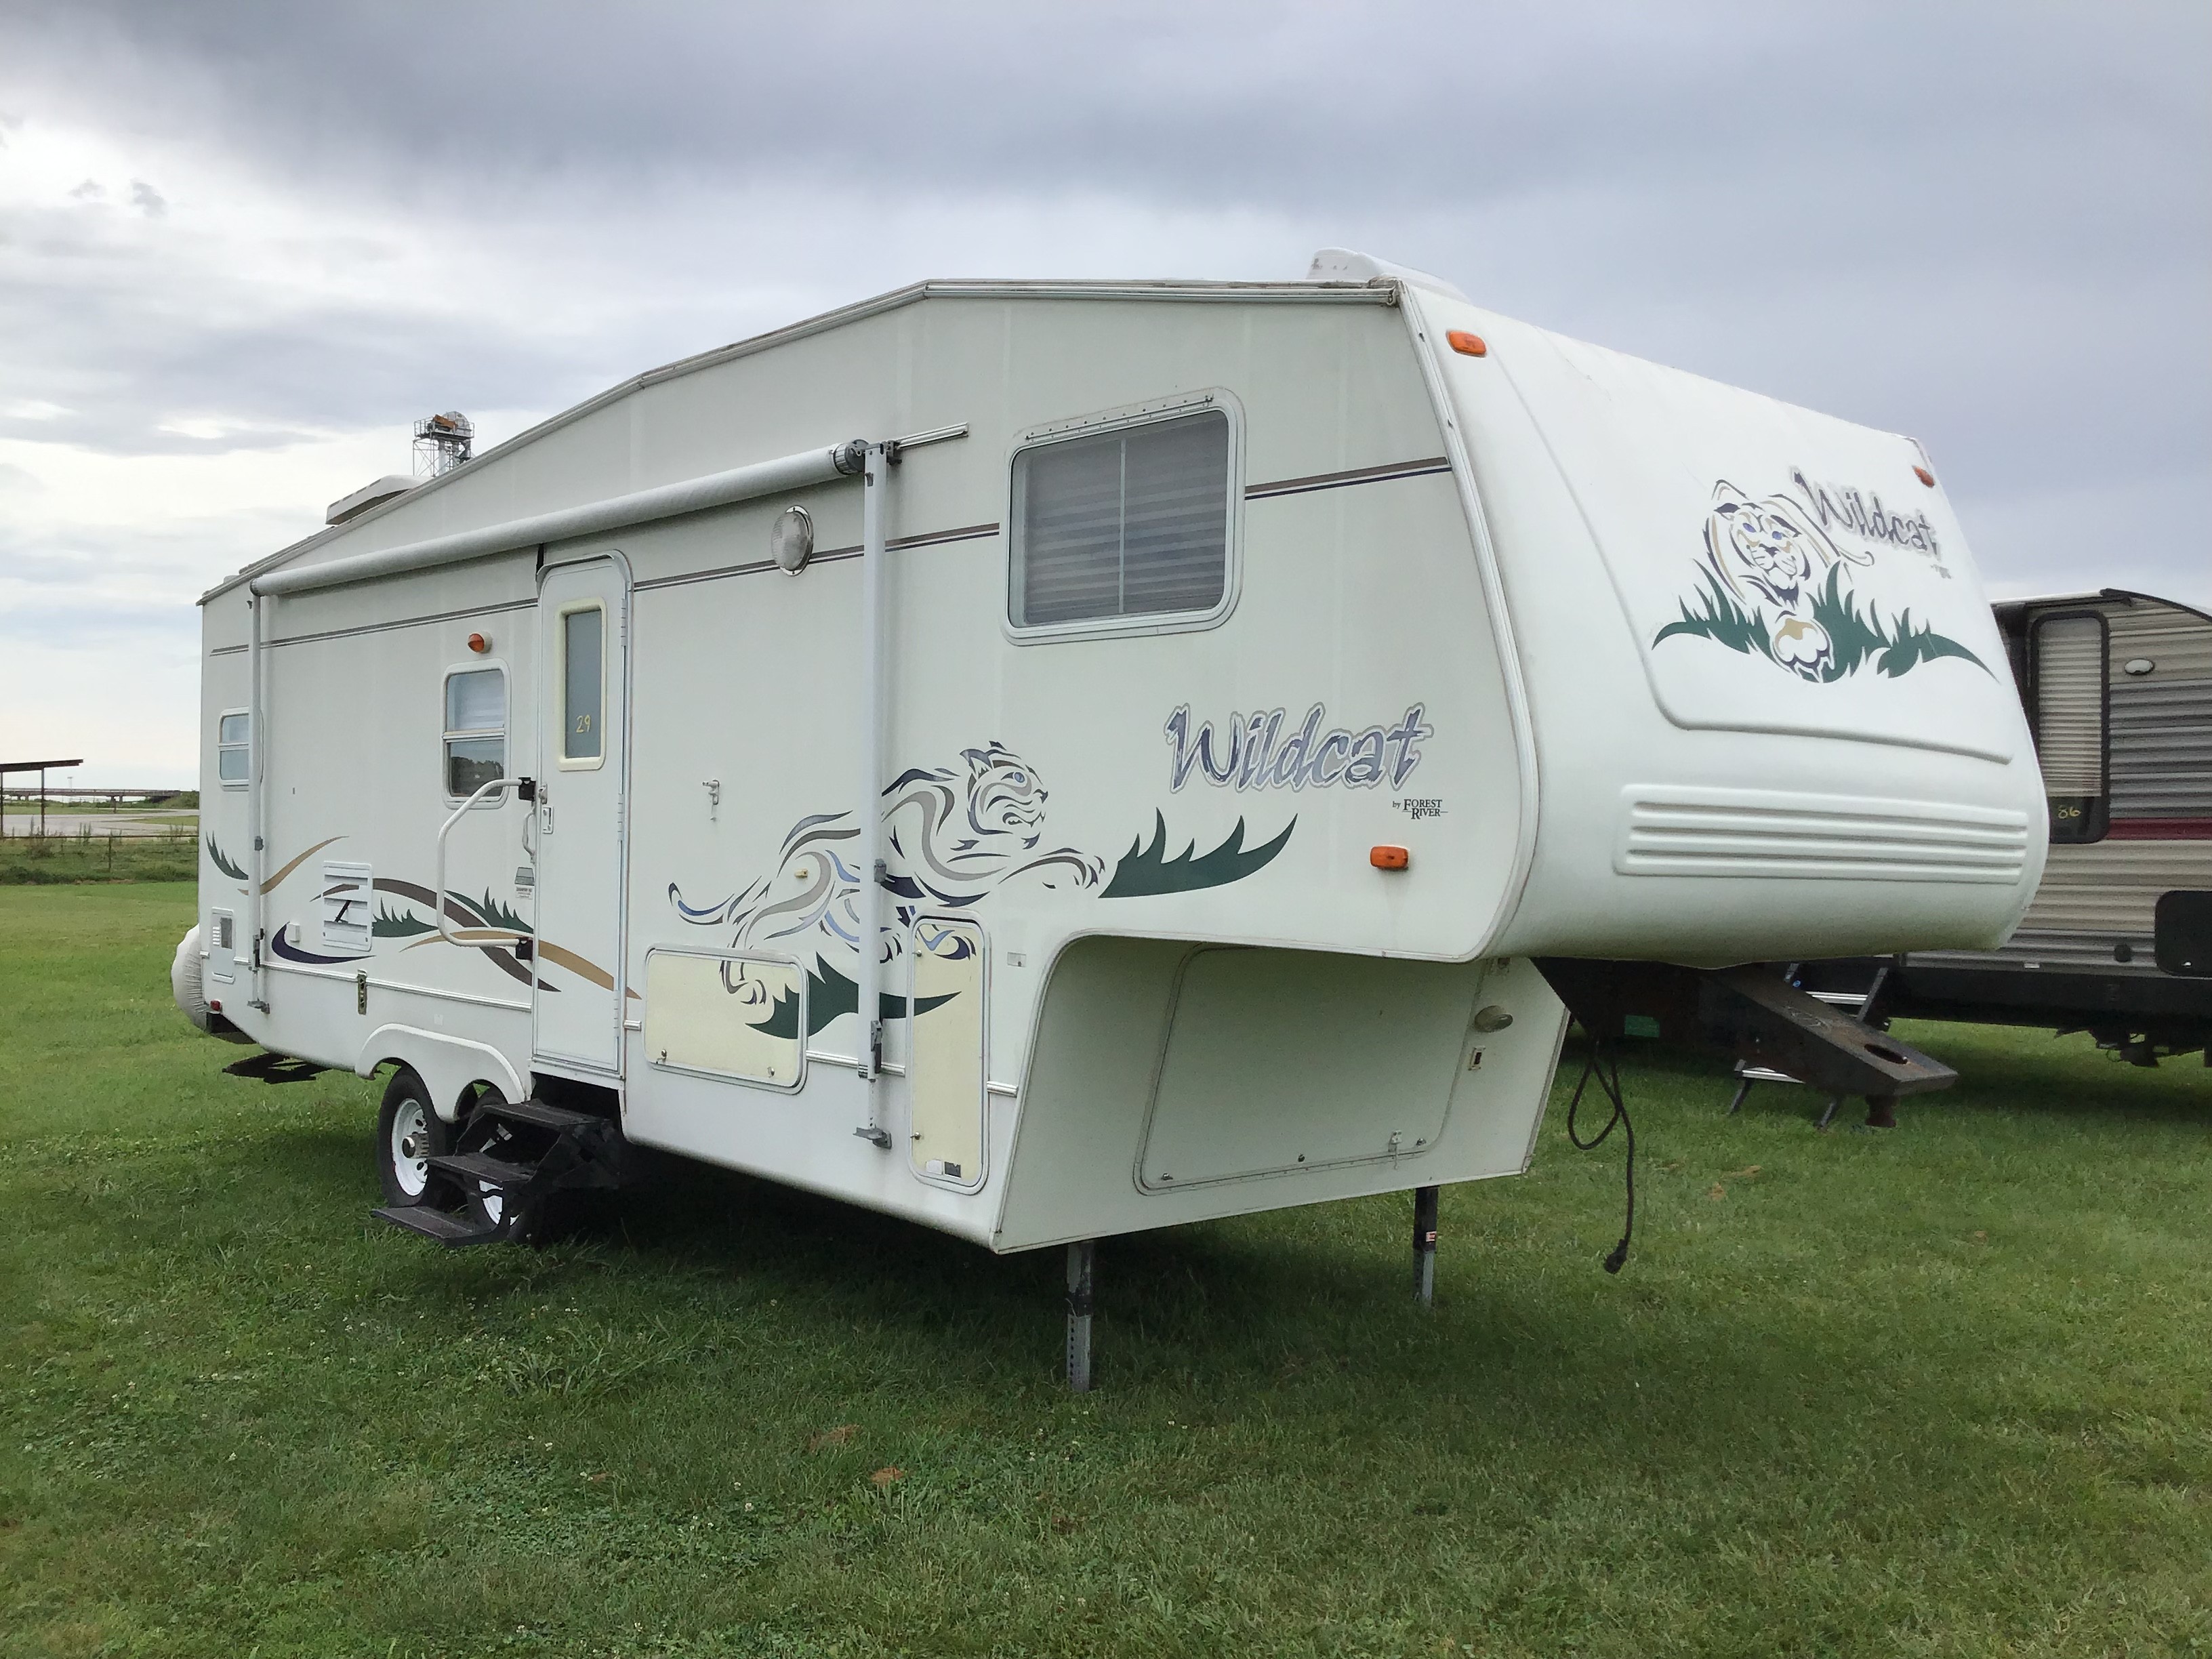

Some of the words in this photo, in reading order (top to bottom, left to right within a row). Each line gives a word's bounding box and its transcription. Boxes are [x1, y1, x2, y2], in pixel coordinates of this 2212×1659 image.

[1789, 465, 1942, 562] Wildcat
[576, 714, 591, 733] 29
[1164, 702, 1434, 794] Wildcat
[1392, 800, 1401, 809] by
[1404, 798, 1443, 811] FOREST
[2057, 805, 2081, 819] 86
[1411, 807, 1441, 819] RIVER
